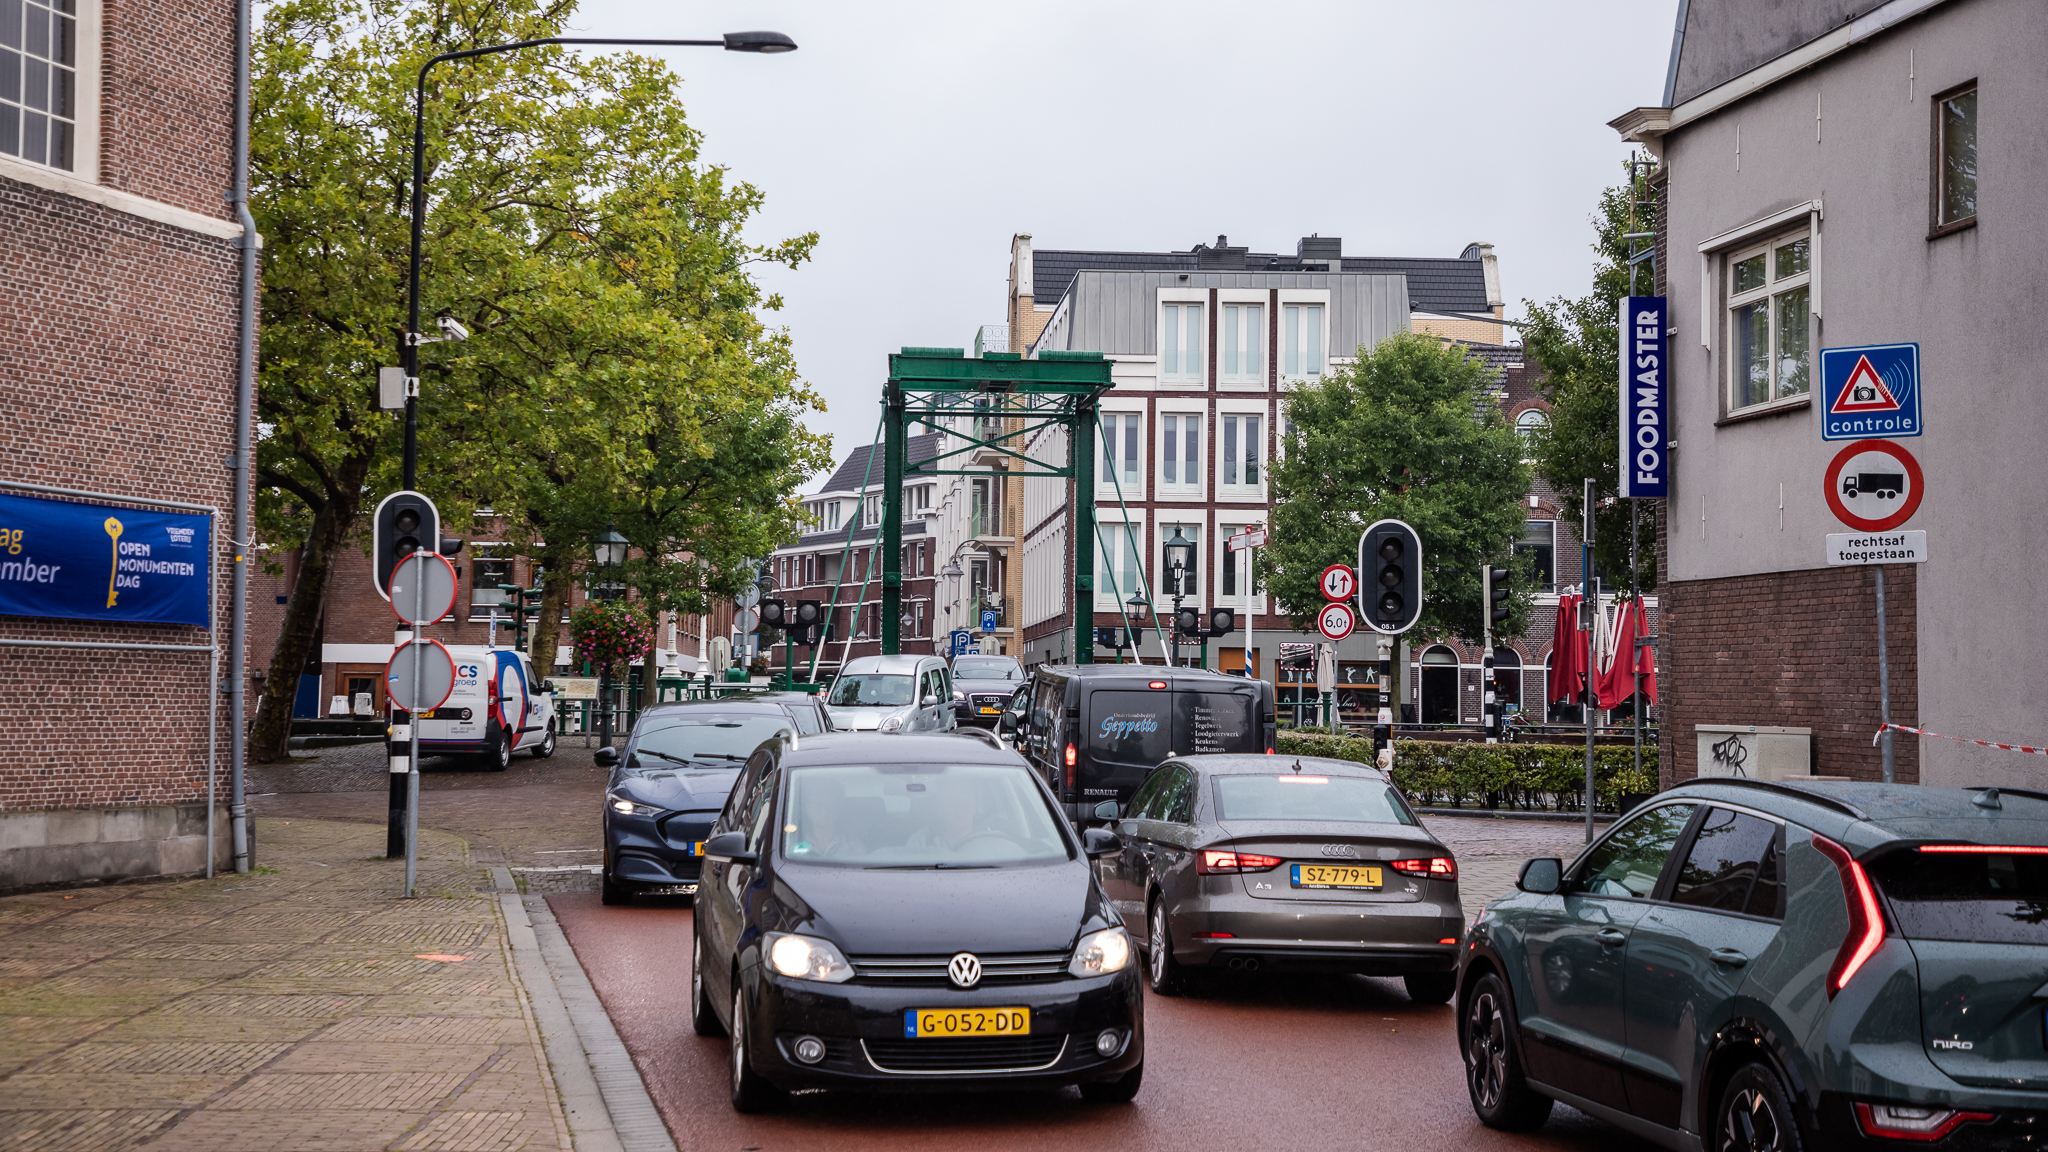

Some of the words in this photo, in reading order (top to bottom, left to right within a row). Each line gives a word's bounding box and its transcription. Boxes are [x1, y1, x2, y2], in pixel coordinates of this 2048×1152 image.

[1636, 310, 1660, 484] FOODMASTER
[1830, 415, 1912, 433] controle
[165, 527, 195, 535] VRIENDEN
[170, 535, 191, 543] LOTERIJ
[1848, 535, 1905, 548] rechtsaf
[119, 542, 150, 556] OPEN
[1839, 549, 1915, 563] toegestaan
[0, 556, 61, 584] mber
[118, 558, 195, 576] MONUMENTEN
[116, 573, 141, 588] DAG
[959, 637, 967, 646] P
[1099, 716, 1158, 740] Geppetto
[1194, 730, 1240, 738] Loodgieterswerk
[1084, 788, 1119, 796] RENAULT
[1307, 867, 1375, 883] SZ-779-L
[1255, 881, 1272, 890] A3
[923, 1012, 1024, 1033] G-052-DD
